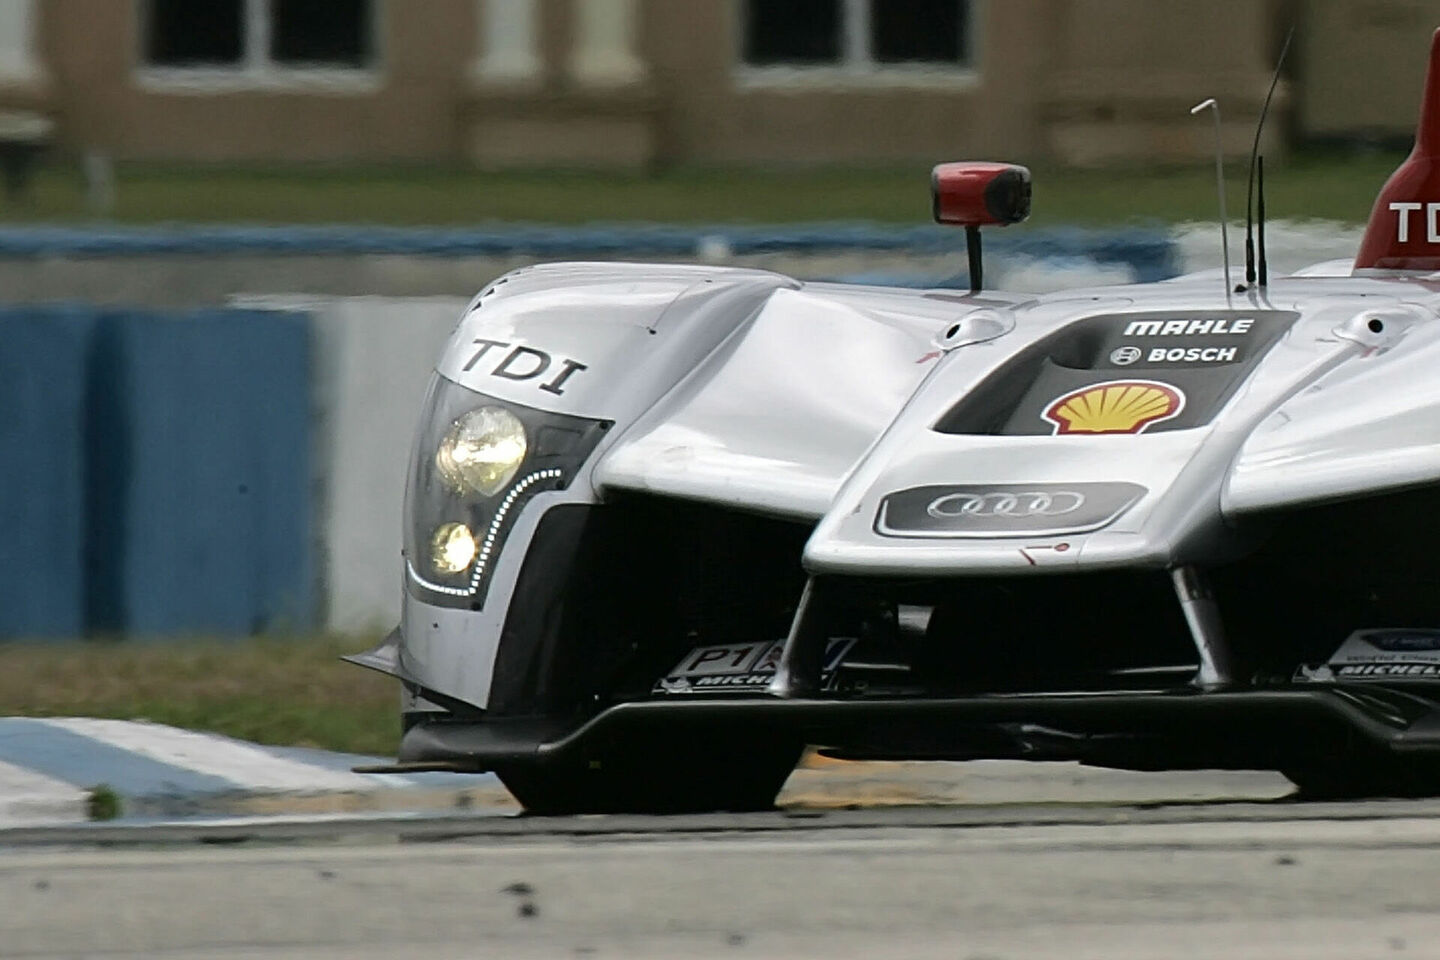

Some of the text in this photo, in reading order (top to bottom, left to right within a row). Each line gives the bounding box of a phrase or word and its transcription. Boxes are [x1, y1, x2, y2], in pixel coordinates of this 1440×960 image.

[1124, 319, 1255, 336] MAHLE
[1147, 347, 1237, 362] BOSCH
[462, 338, 588, 396] TDI
[687, 647, 754, 672] P1
